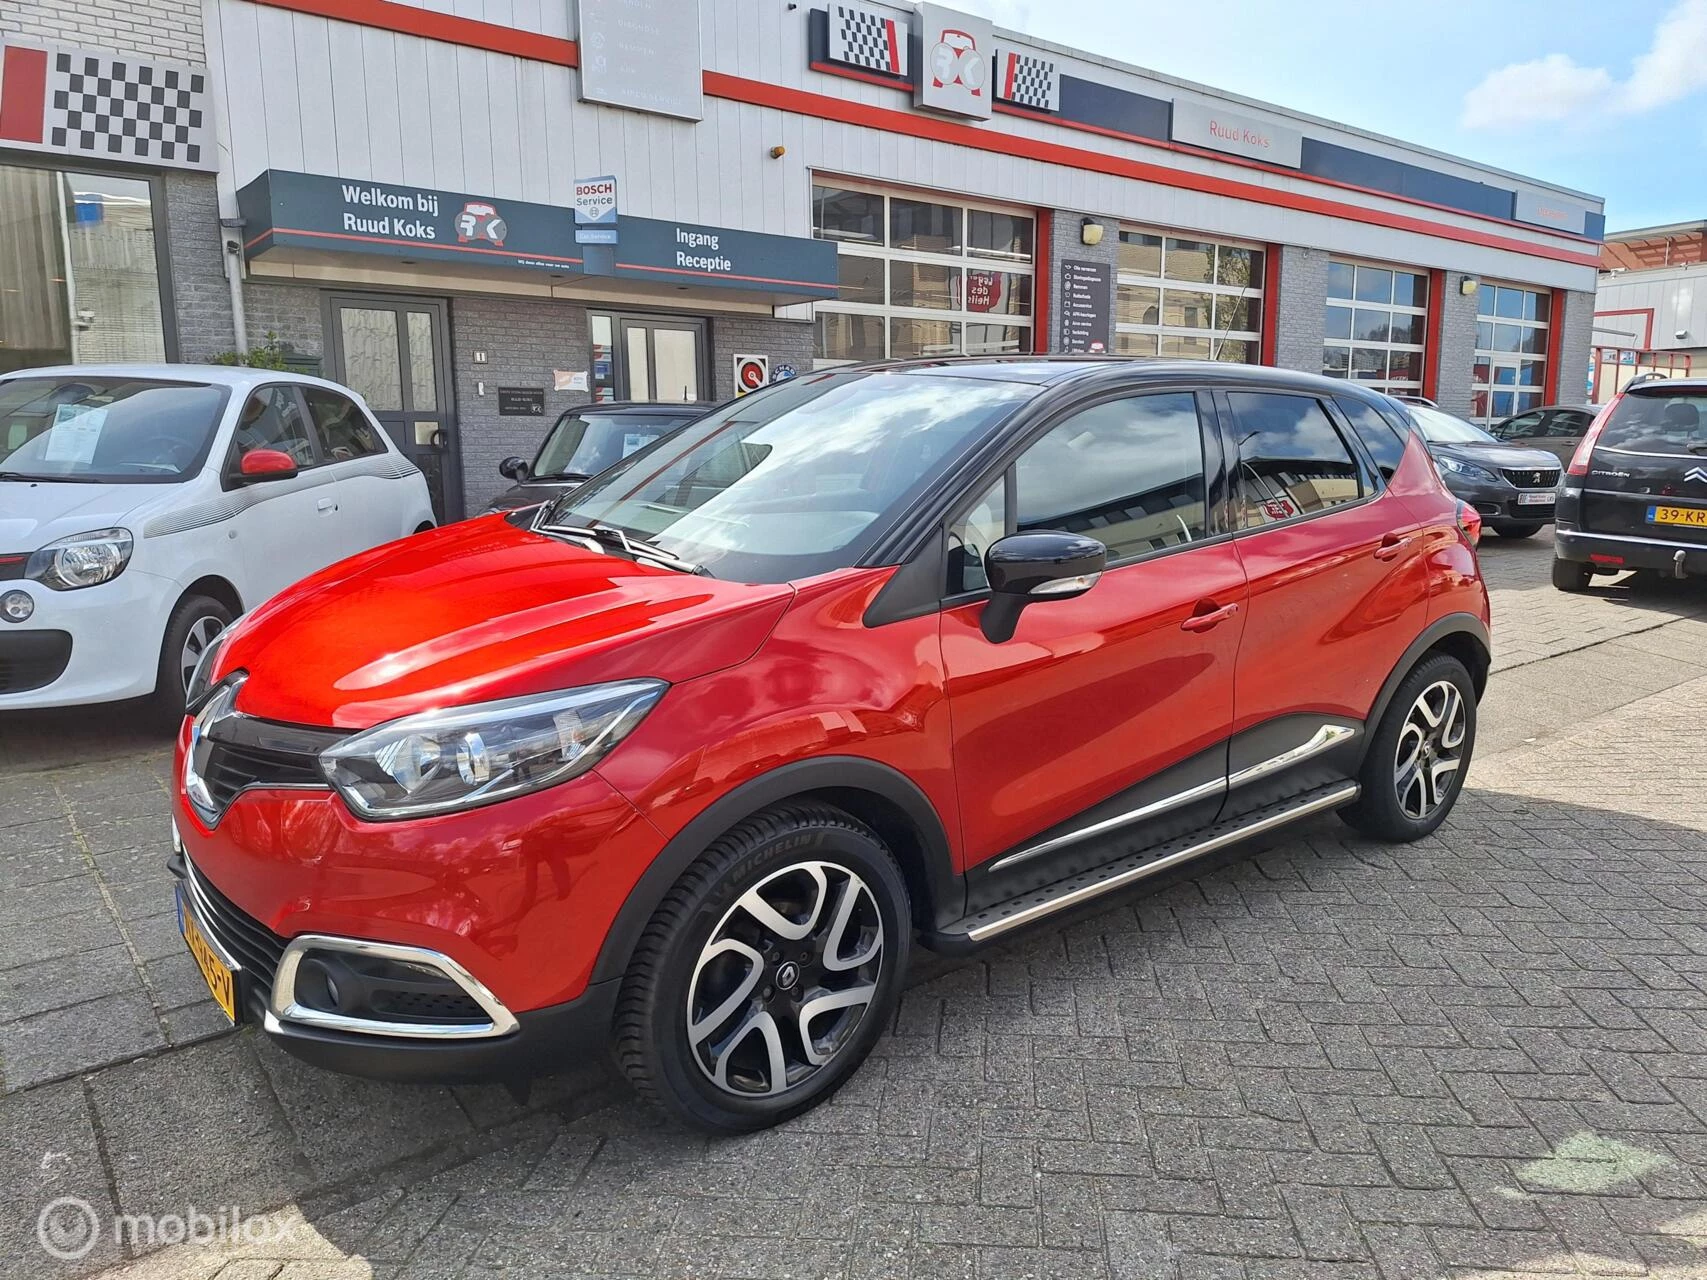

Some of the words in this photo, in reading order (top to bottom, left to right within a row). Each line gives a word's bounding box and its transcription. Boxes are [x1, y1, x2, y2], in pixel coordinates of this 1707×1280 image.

[1209, 119, 1239, 141] Ruud
[1243, 128, 1270, 148] Koks
[341, 184, 413, 210] Welkom
[417, 193, 439, 217] bij
[576, 183, 612, 196] BOSCH
[576, 196, 613, 206] Service
[343, 212, 390, 235] Ruud
[393, 218, 436, 240] Koks
[676, 227, 719, 250] Ingang
[676, 251, 732, 272] Receptie
[1660, 508, 1706, 523] 39-KR
[732, 833, 812, 882] MICHELIN
